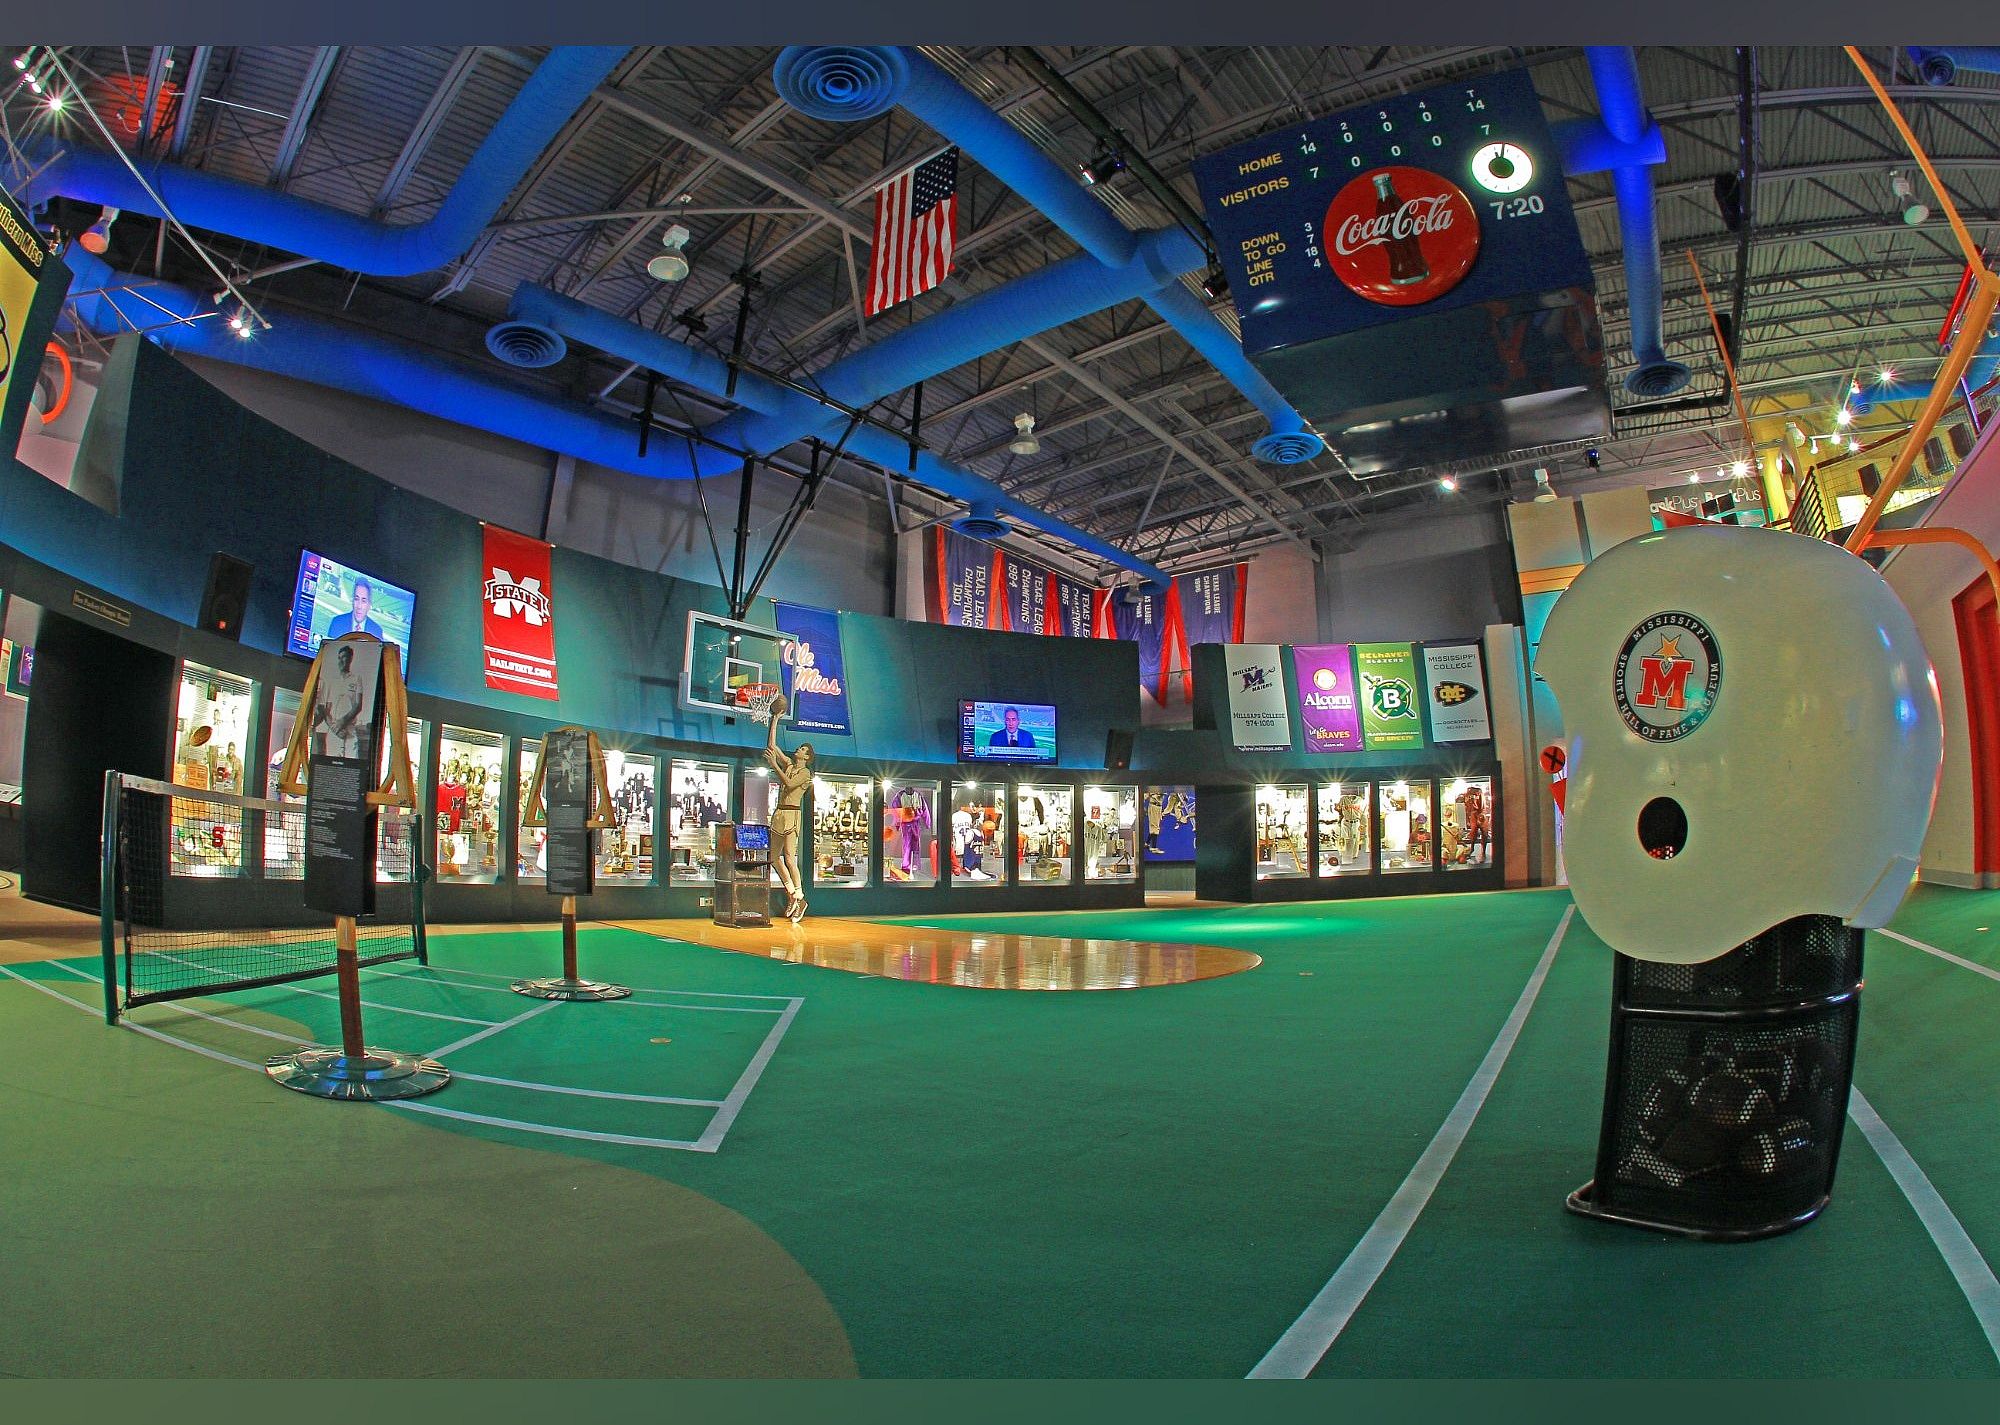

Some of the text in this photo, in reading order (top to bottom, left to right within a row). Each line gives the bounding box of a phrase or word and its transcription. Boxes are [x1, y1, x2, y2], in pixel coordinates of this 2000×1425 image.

[1301, 89, 1475, 142] 1 2 3 4 T
[1238, 99, 1485, 175] HOME 14 0 0 0 14
[1220, 124, 1490, 207] VISITORS 7 0 0 0 7
[1489, 195, 1544, 220] 7:20
[1241, 222, 1313, 251] DOWN 3
[1335, 194, 1454, 256] Coca-Cola
[20, 232, 43, 267] Miss
[1244, 234, 1314, 263] TO GO 7
[1246, 247, 1318, 275] LINE 18
[1249, 258, 1322, 287] QTR 4
[1650, 495, 1698, 513] ankPlus
[975, 565, 986, 597] TEXAS
[1034, 575, 1044, 605] TEXAS
[496, 585, 539, 609] STATE
[962, 567, 974, 628] CHAMPIONS
[1021, 568, 1032, 624] CHAMPIONS
[1082, 593, 1090, 619] TEXAS
[1633, 616, 1710, 642] MISSISSIPPI
[784, 640, 815, 667] Ole
[1428, 653, 1476, 663] MISSISSIPPI
[1433, 662, 1473, 671] COLLEGE
[794, 665, 842, 696] Miss
[1232, 664, 1258, 677] MILLSAPS
[1616, 653, 1628, 701] SPORTS
[1635, 656, 1695, 711] M
[1304, 692, 1352, 706] Alcorn
[1381, 688, 1401, 709] B
[1620, 703, 1640, 730] HALL
[1690, 717, 1698, 726] &
[1316, 731, 1351, 740] BRAVES
[1642, 726, 1656, 738] OF
[1660, 723, 1688, 739] FAME
